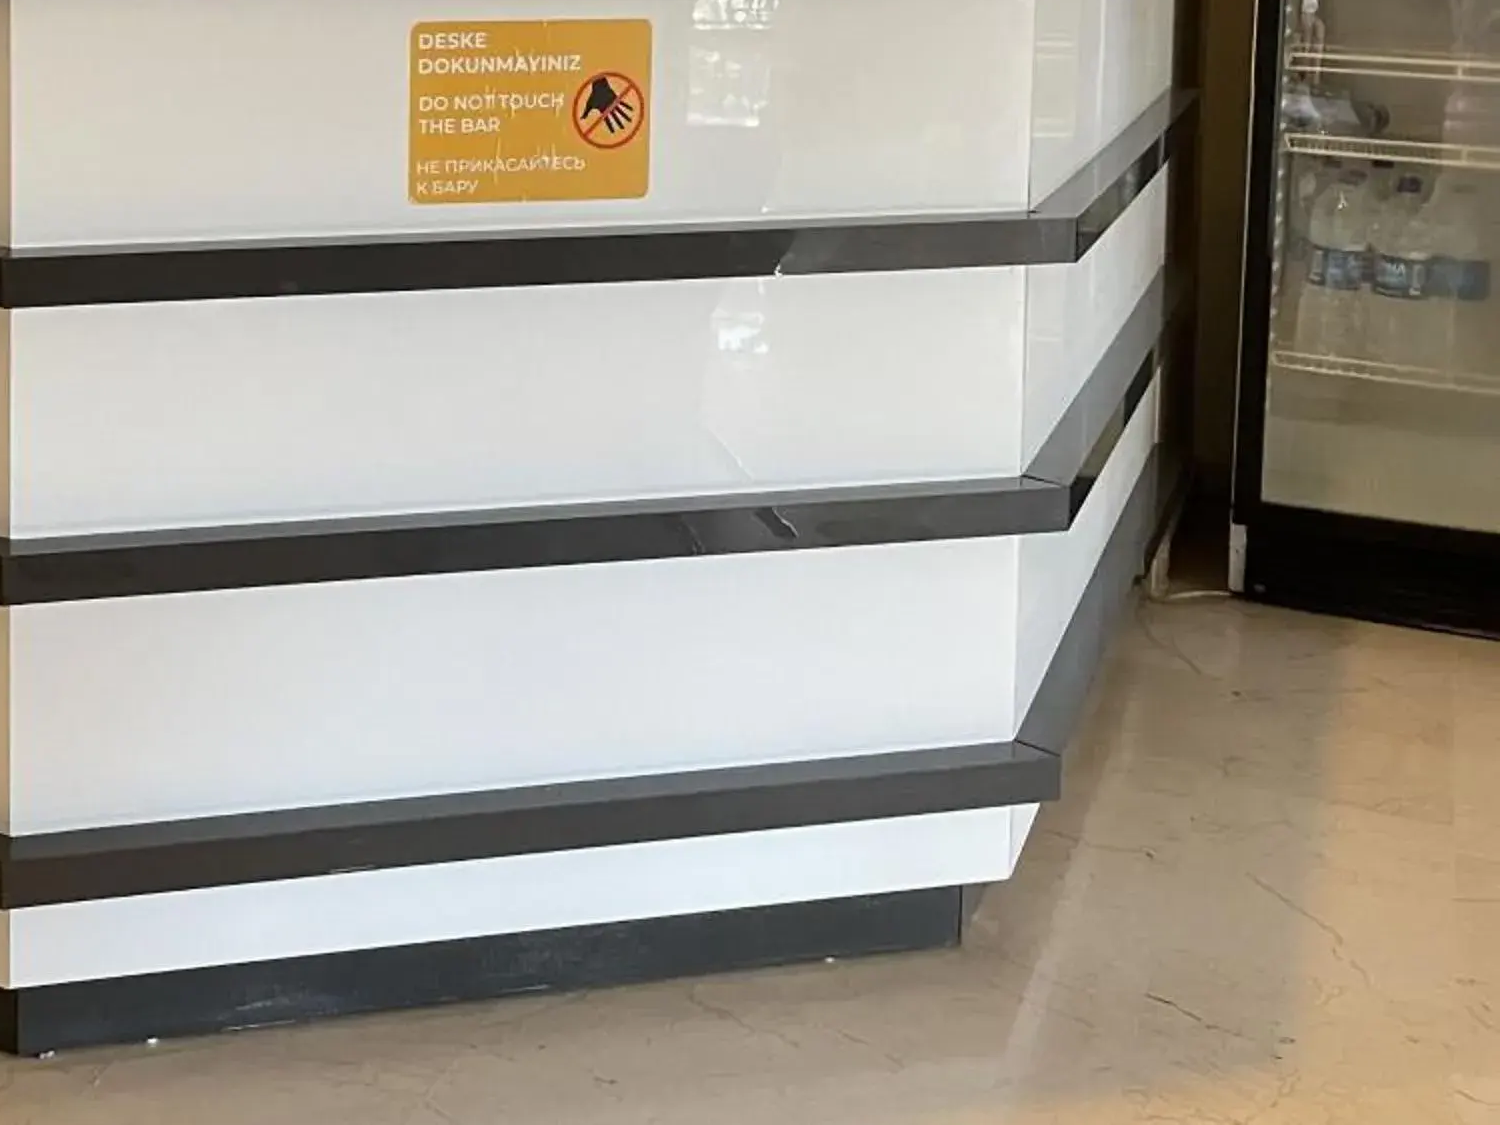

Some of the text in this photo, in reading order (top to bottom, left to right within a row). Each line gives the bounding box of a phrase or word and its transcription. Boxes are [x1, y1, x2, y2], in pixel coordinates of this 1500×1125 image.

[418, 32, 488, 50] DESKE
[418, 54, 582, 75] DOKUNMAYINIZ
[419, 92, 565, 112] DO NOT TOUCH
[418, 116, 501, 134] THE BAR
[416, 155, 587, 175] НЕ ПРИКАСАЙТЕСЬ
[431, 179, 479, 195] БАРУ
